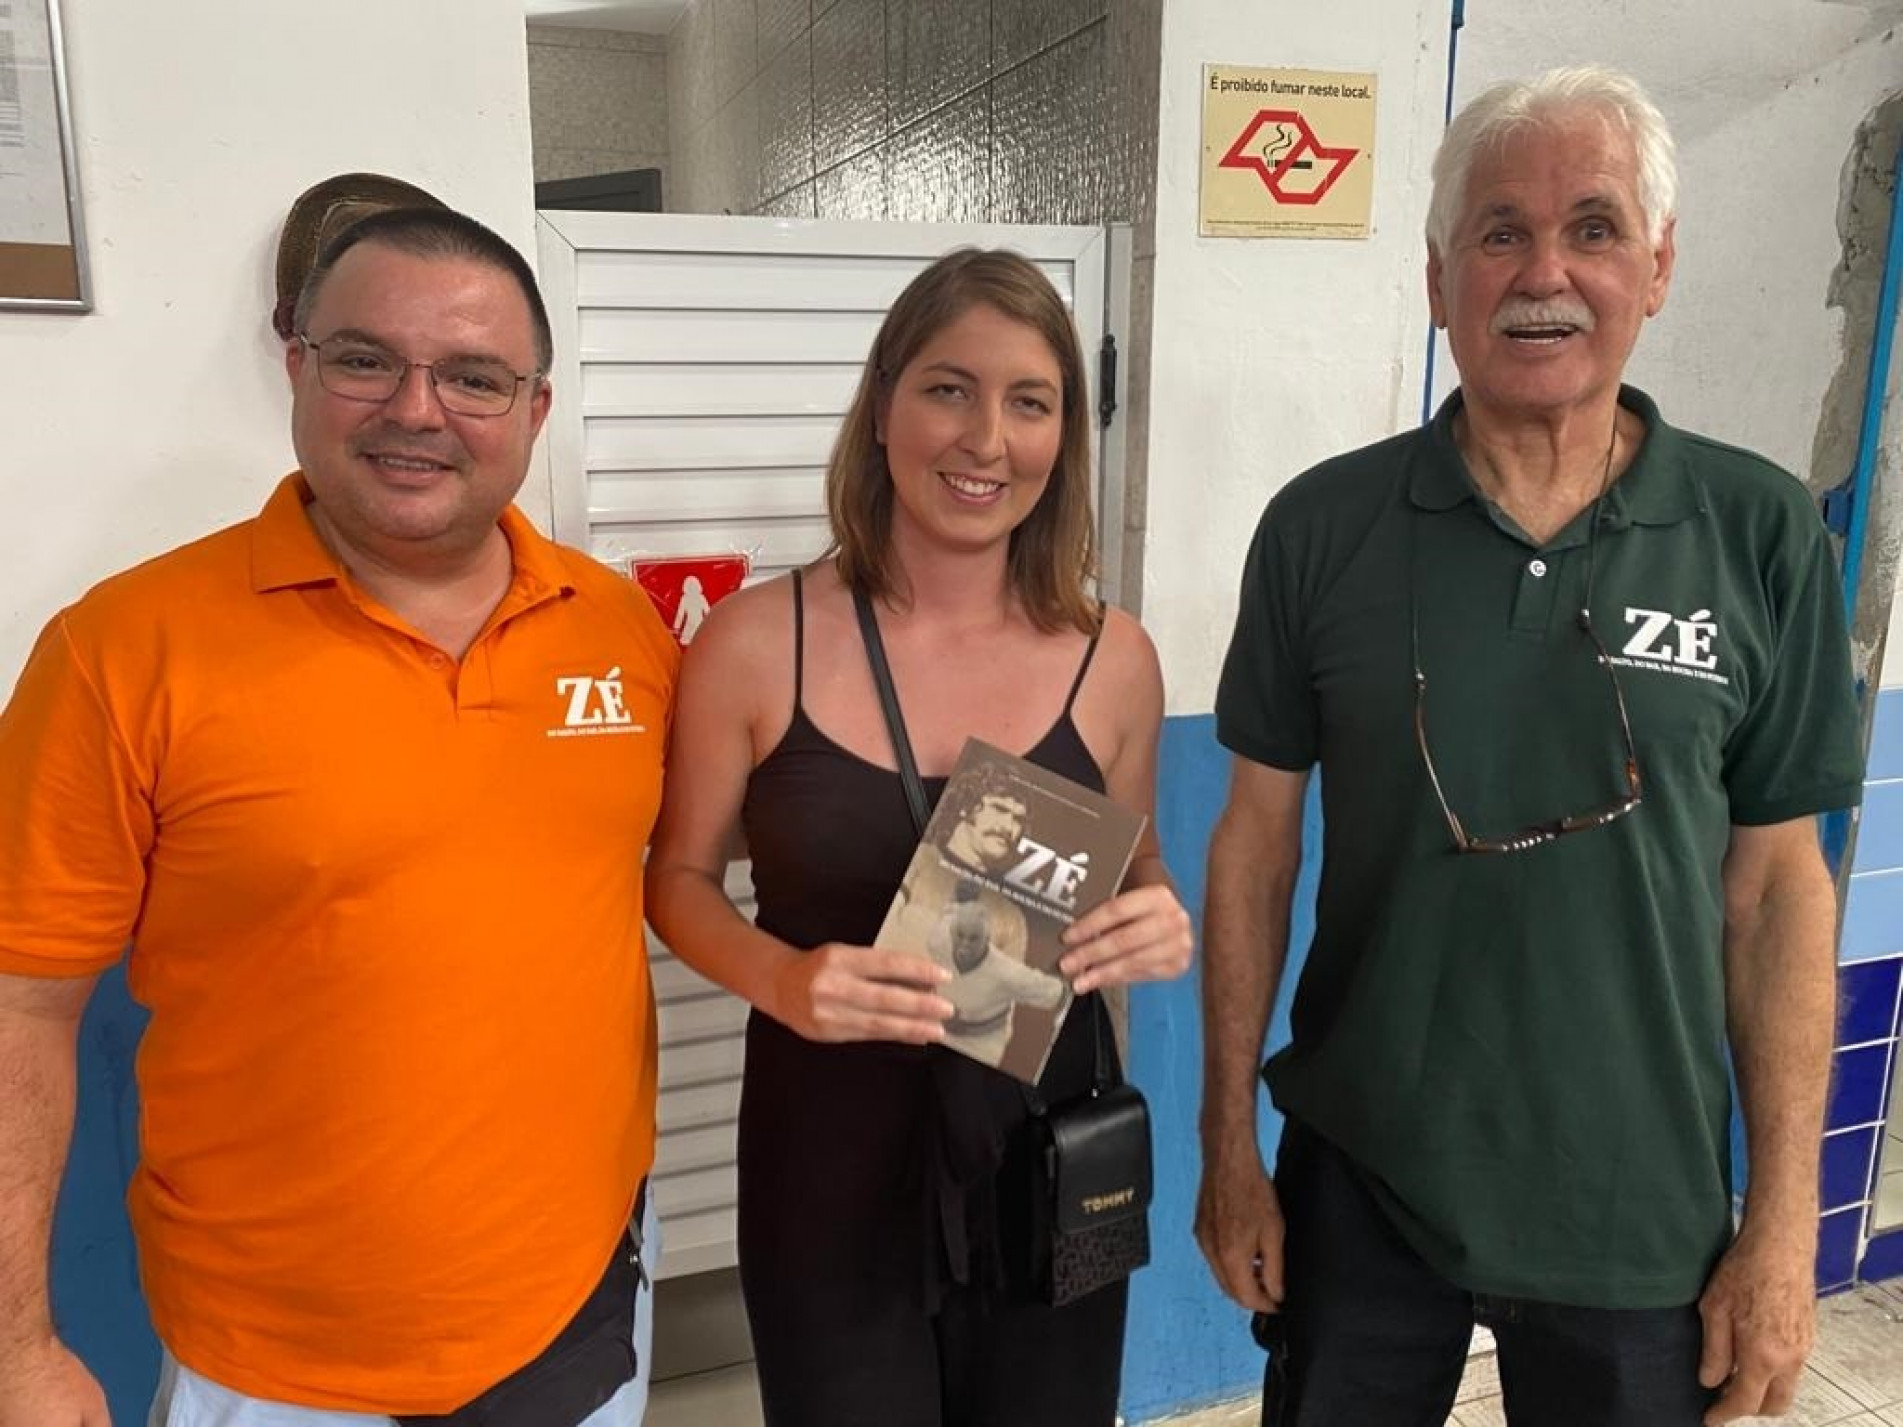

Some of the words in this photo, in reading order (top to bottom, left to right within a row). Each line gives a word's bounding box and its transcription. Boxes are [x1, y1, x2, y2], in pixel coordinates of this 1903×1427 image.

[1210, 72, 1219, 90] É
[1220, 78, 1268, 94] proibido
[1270, 79, 1306, 94] fumar
[1307, 84, 1339, 98] neste
[1341, 84, 1372, 100] local.
[1622, 606, 1718, 670] ZÉ
[556, 665, 633, 727] ZÉ
[1003, 836, 1090, 908] ZÉ
[1081, 1186, 1135, 1216] TOMMY
